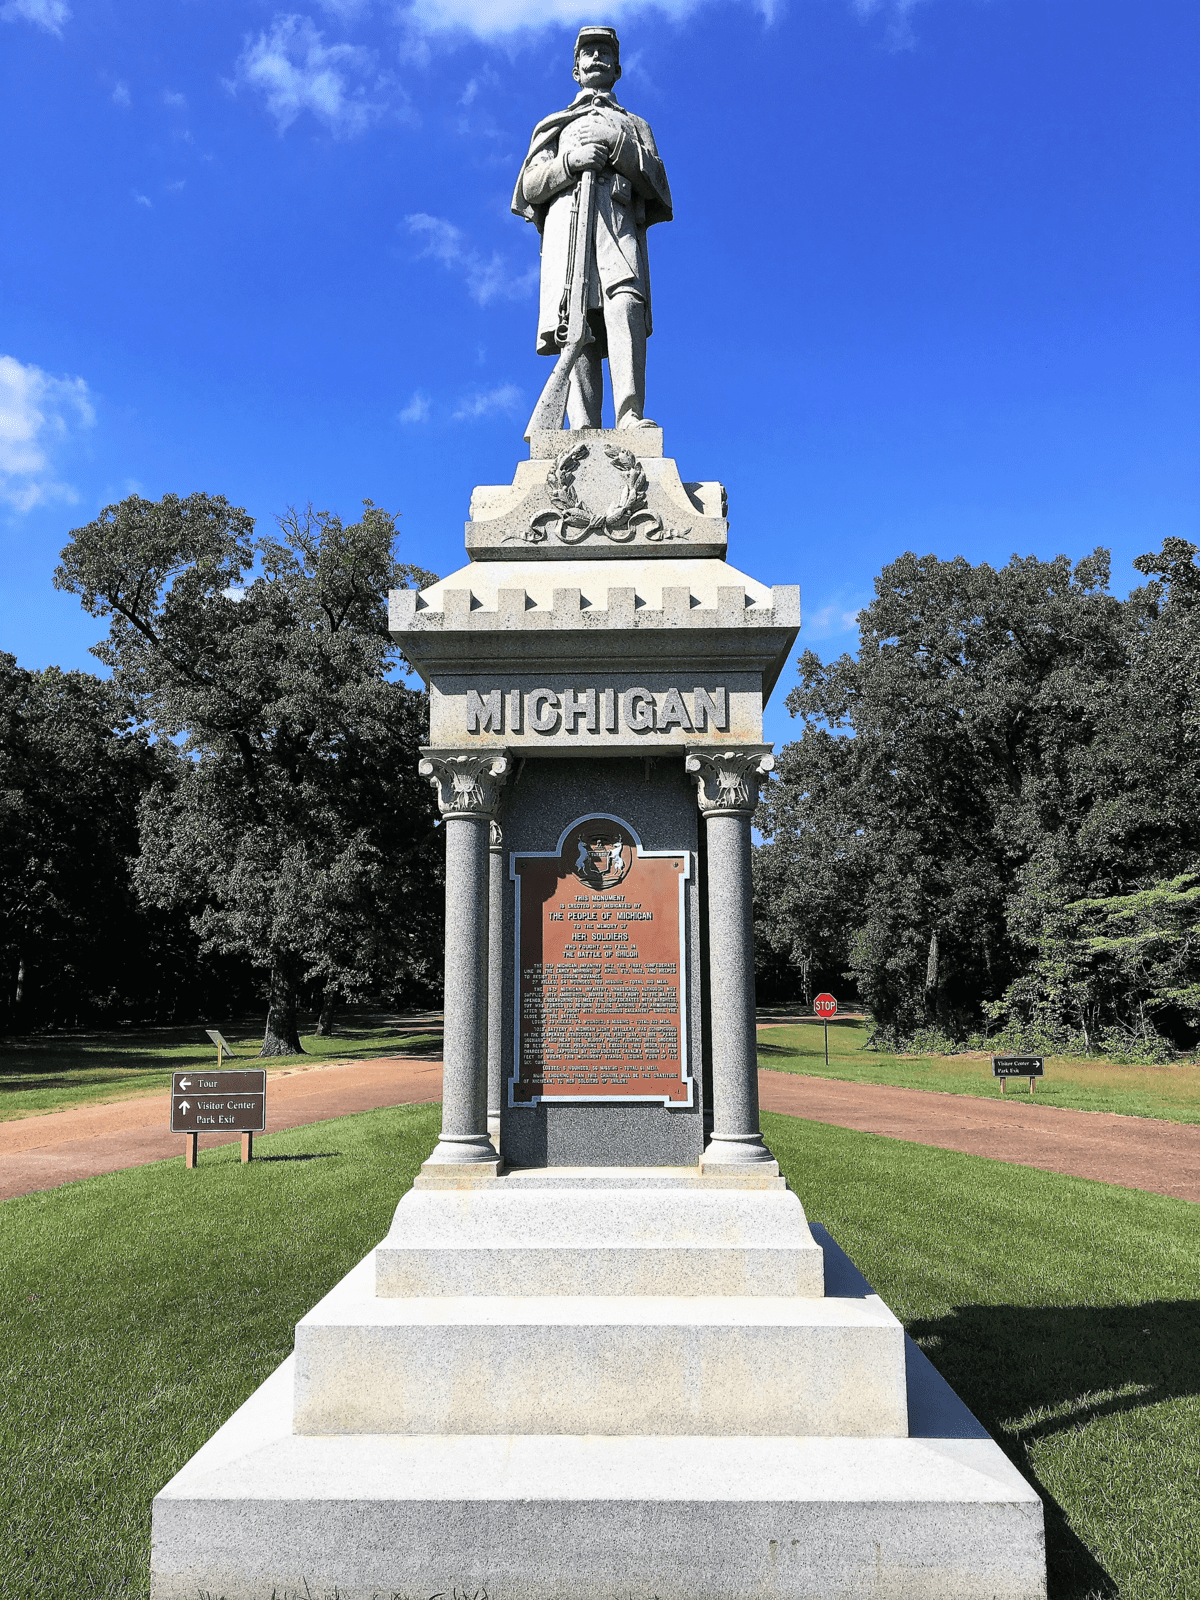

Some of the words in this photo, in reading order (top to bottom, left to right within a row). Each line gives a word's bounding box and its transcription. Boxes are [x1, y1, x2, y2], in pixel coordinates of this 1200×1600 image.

[466, 687, 730, 734] MICHIGAN
[549, 912, 564, 921] THE
[568, 912, 598, 921] PEOPLE
[601, 912, 612, 921] OF
[617, 912, 653, 921] MICHIGAN
[572, 932, 588, 942] HER
[592, 932, 629, 942] SOLDIERS
[816, 1001, 836, 1010] STOP
[198, 1080, 218, 1088] Tour
[197, 1102, 224, 1110] Visitor
[227, 1101, 255, 1109] Center
[196, 1115, 215, 1124] Park
[218, 1115, 235, 1124] Exit
